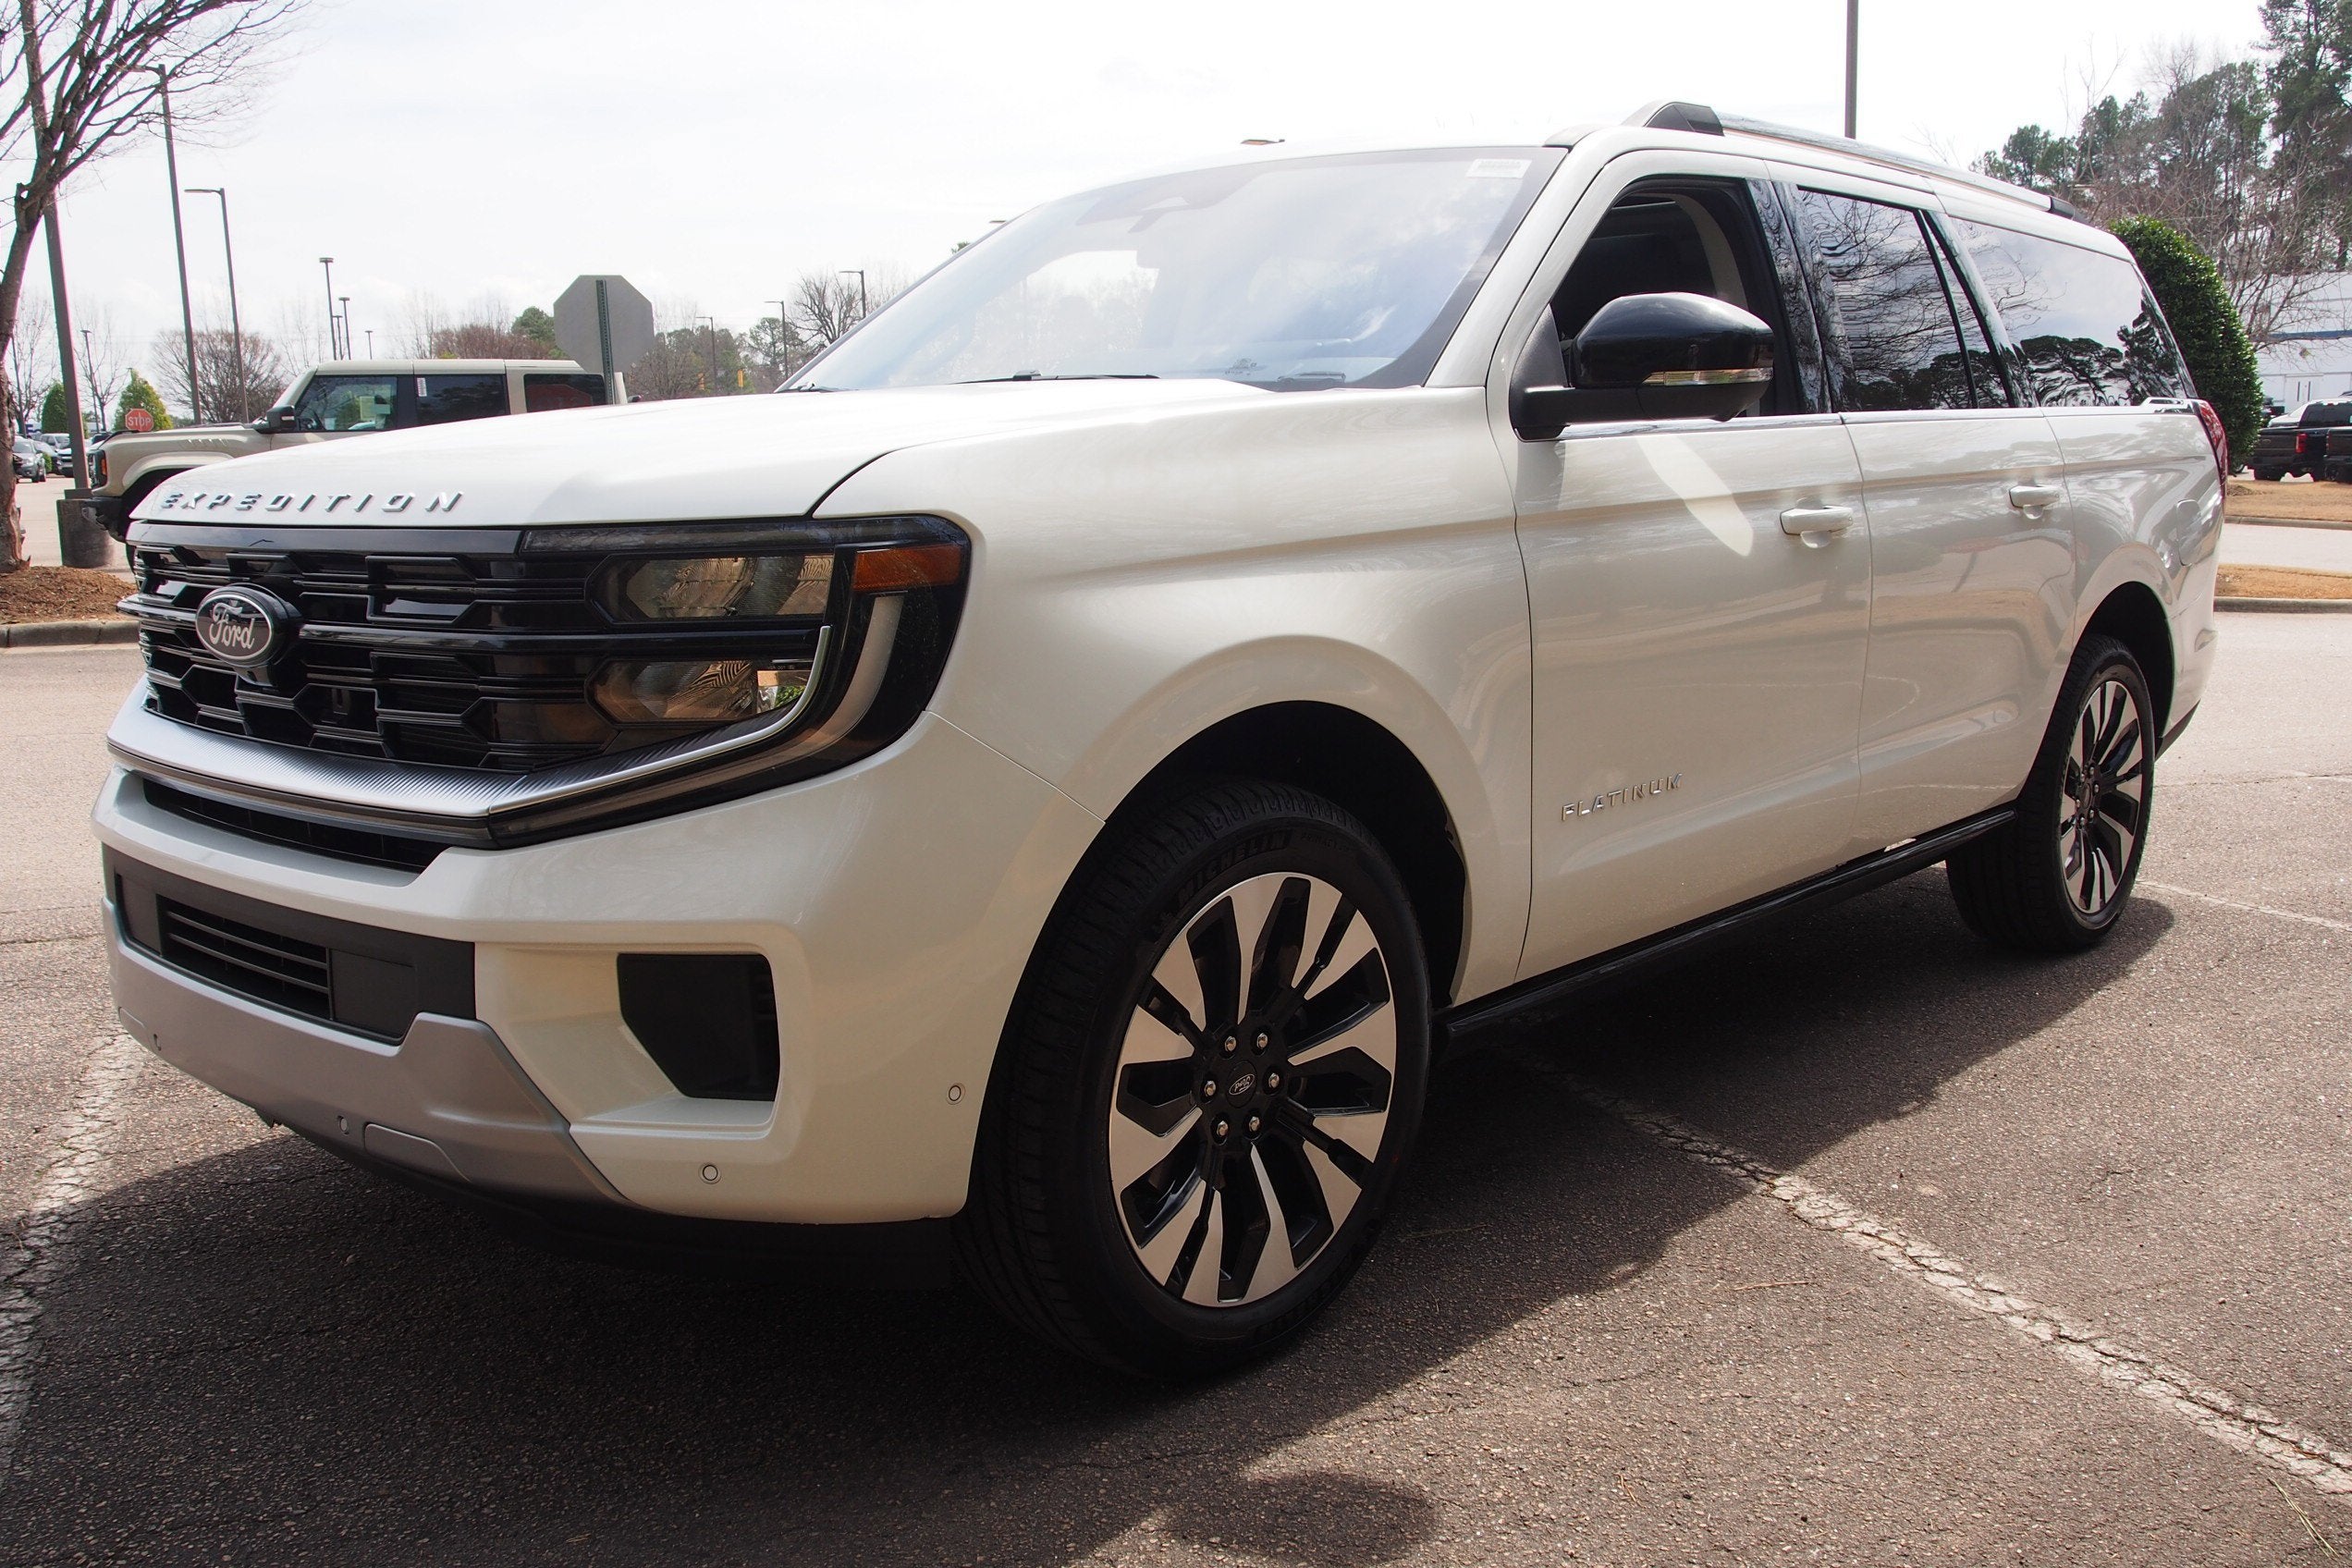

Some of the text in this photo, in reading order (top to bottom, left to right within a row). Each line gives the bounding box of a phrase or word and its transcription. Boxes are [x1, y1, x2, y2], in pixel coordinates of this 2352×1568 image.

[128, 416, 152, 426] STOP
[161, 491, 463, 514] EXPEDITION
[209, 602, 255, 649] Ford
[1562, 773, 1683, 821] PLATINUM
[1177, 831, 1287, 909] MICHELIN
